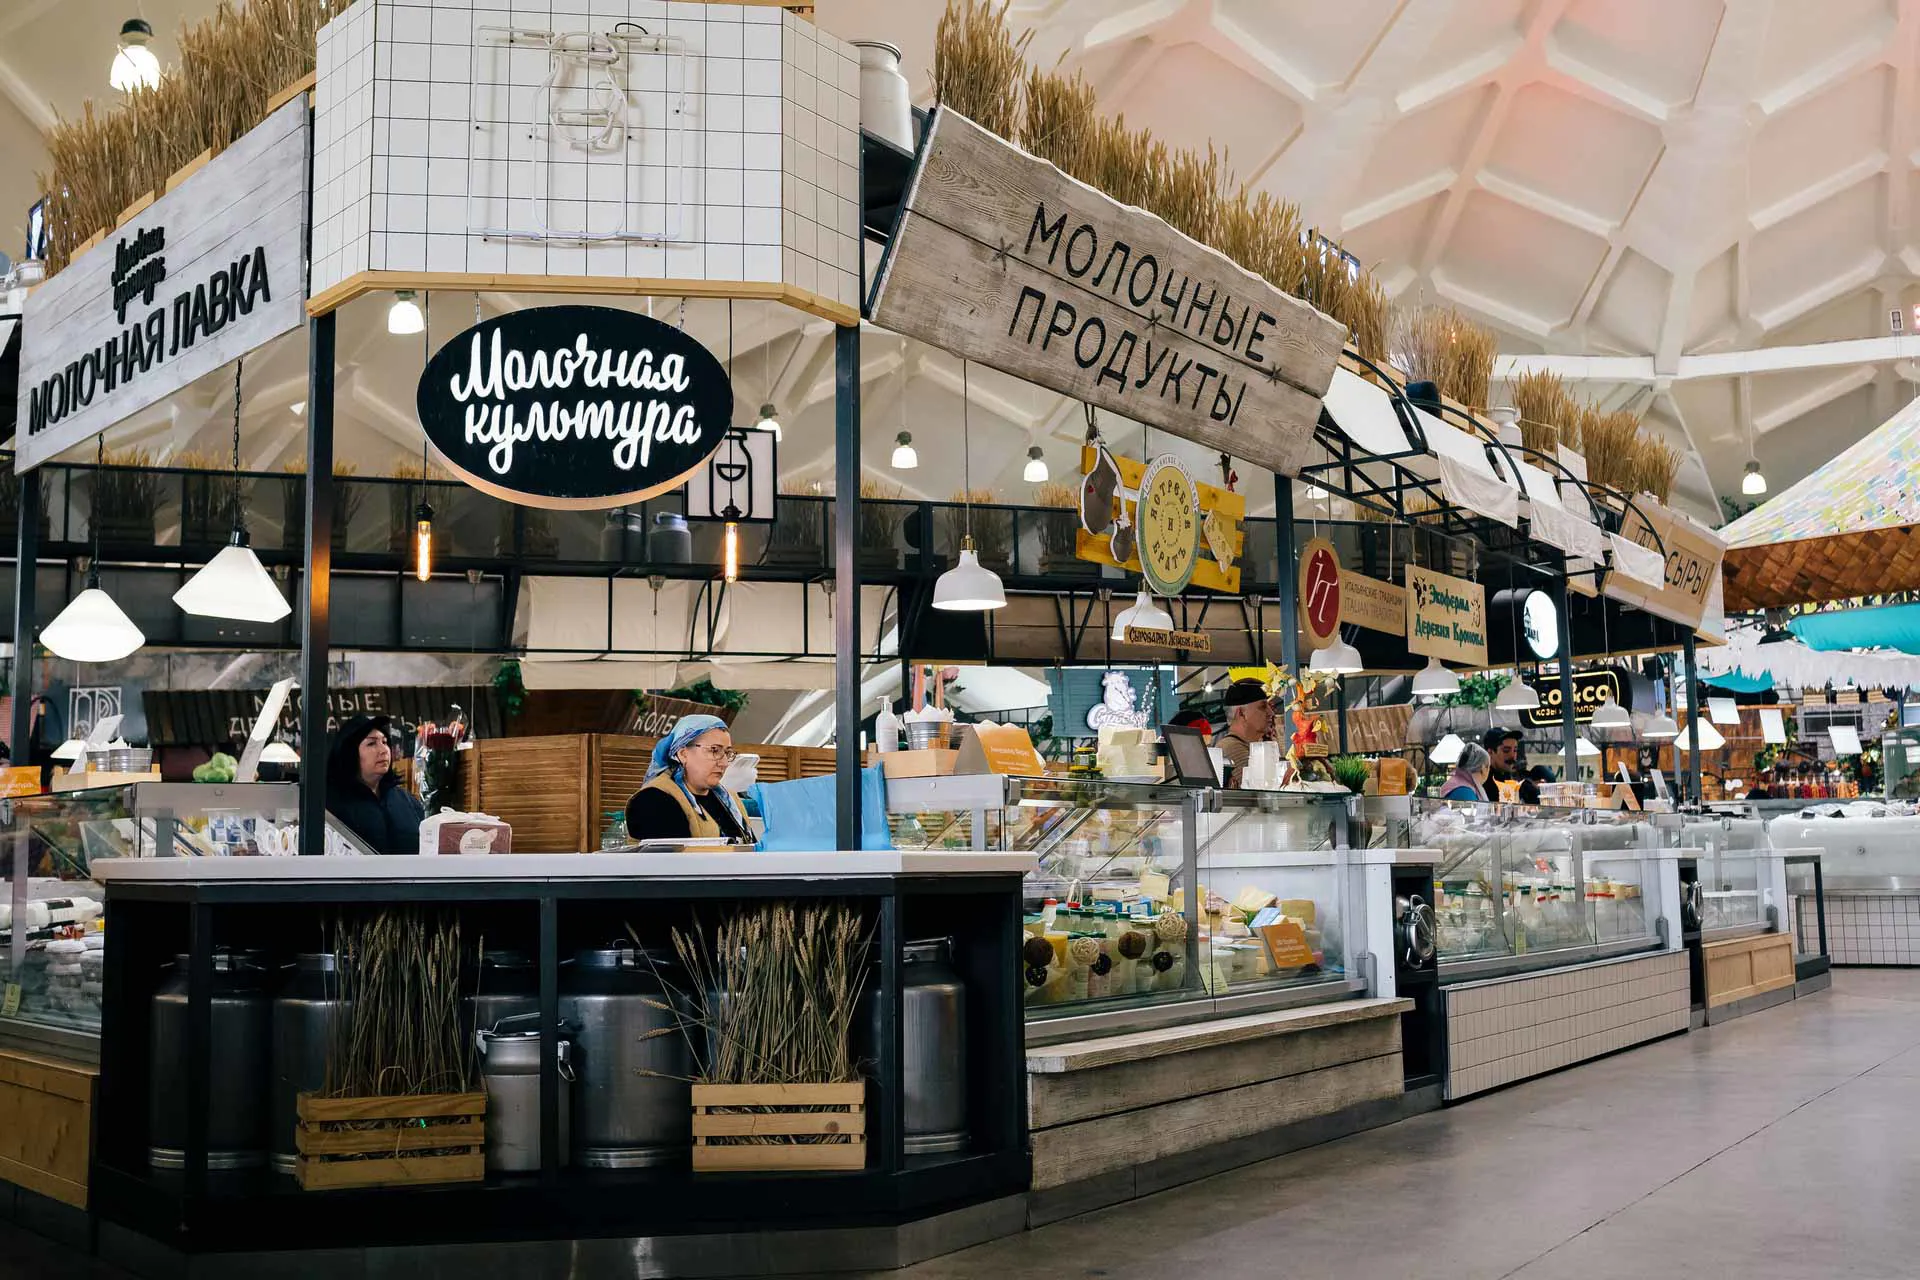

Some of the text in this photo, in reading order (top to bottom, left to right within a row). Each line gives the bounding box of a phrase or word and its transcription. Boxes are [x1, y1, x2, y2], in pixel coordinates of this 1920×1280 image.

[1023, 201, 1278, 363] МОЛОЧНЫЕ
[28, 307, 165, 436] МОЛОЧНАЯ
[169, 246, 271, 356] ЛАВКА
[451, 327, 690, 401] Молочная
[1008, 286, 1247, 426] ПРОДУКТЫ
[465, 399, 701, 475] культура
[1664, 551, 1710, 597] СЫРЫ
